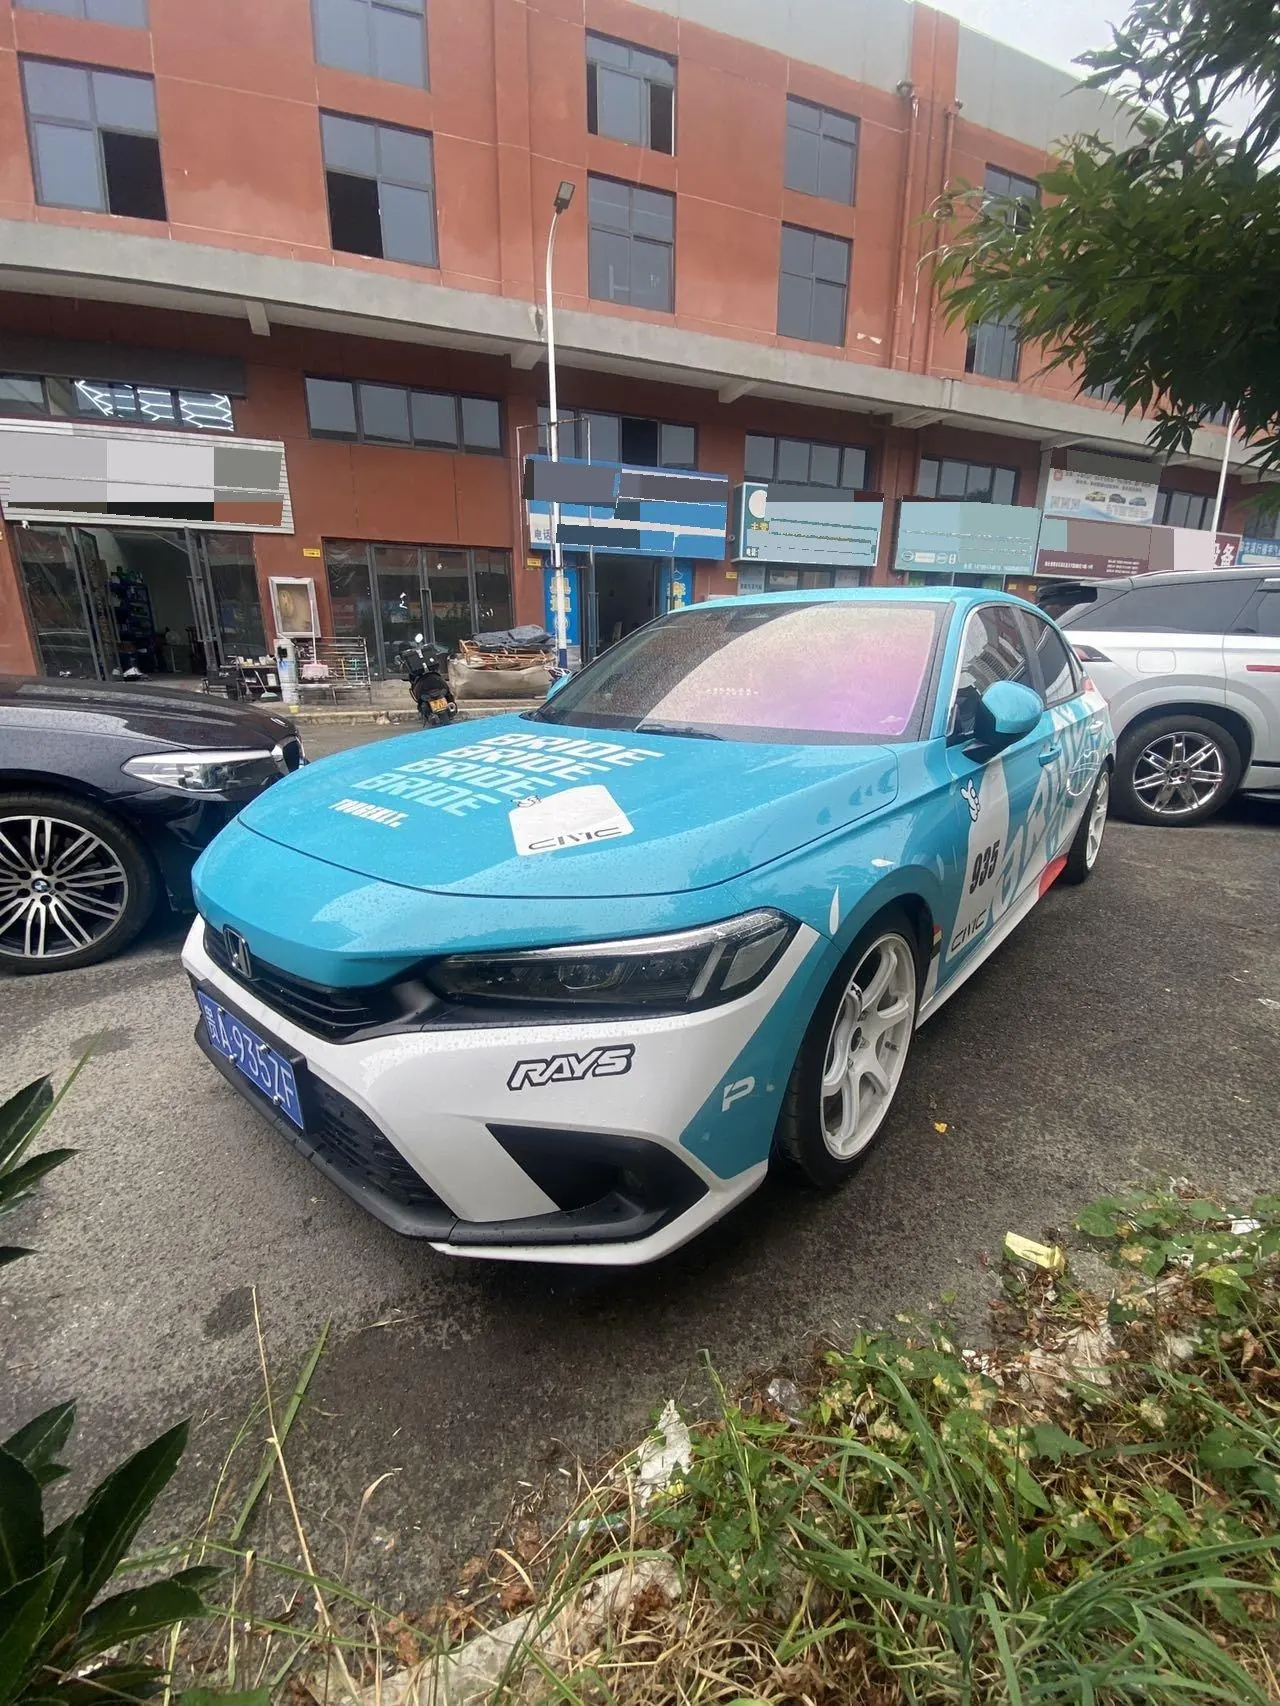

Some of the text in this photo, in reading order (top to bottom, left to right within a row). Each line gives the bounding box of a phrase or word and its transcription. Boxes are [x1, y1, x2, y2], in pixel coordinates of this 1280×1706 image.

[438, 745, 612, 781] BRIDE
[478, 733, 665, 767] BRIDE
[350, 772, 502, 817] BRIDE
[393, 758, 558, 798] BRIDE
[528, 826, 622, 850] CIVIC
[969, 839, 1000, 895] 935
[952, 909, 986, 952] CIVIC
[506, 1043, 636, 1092] RAYS
